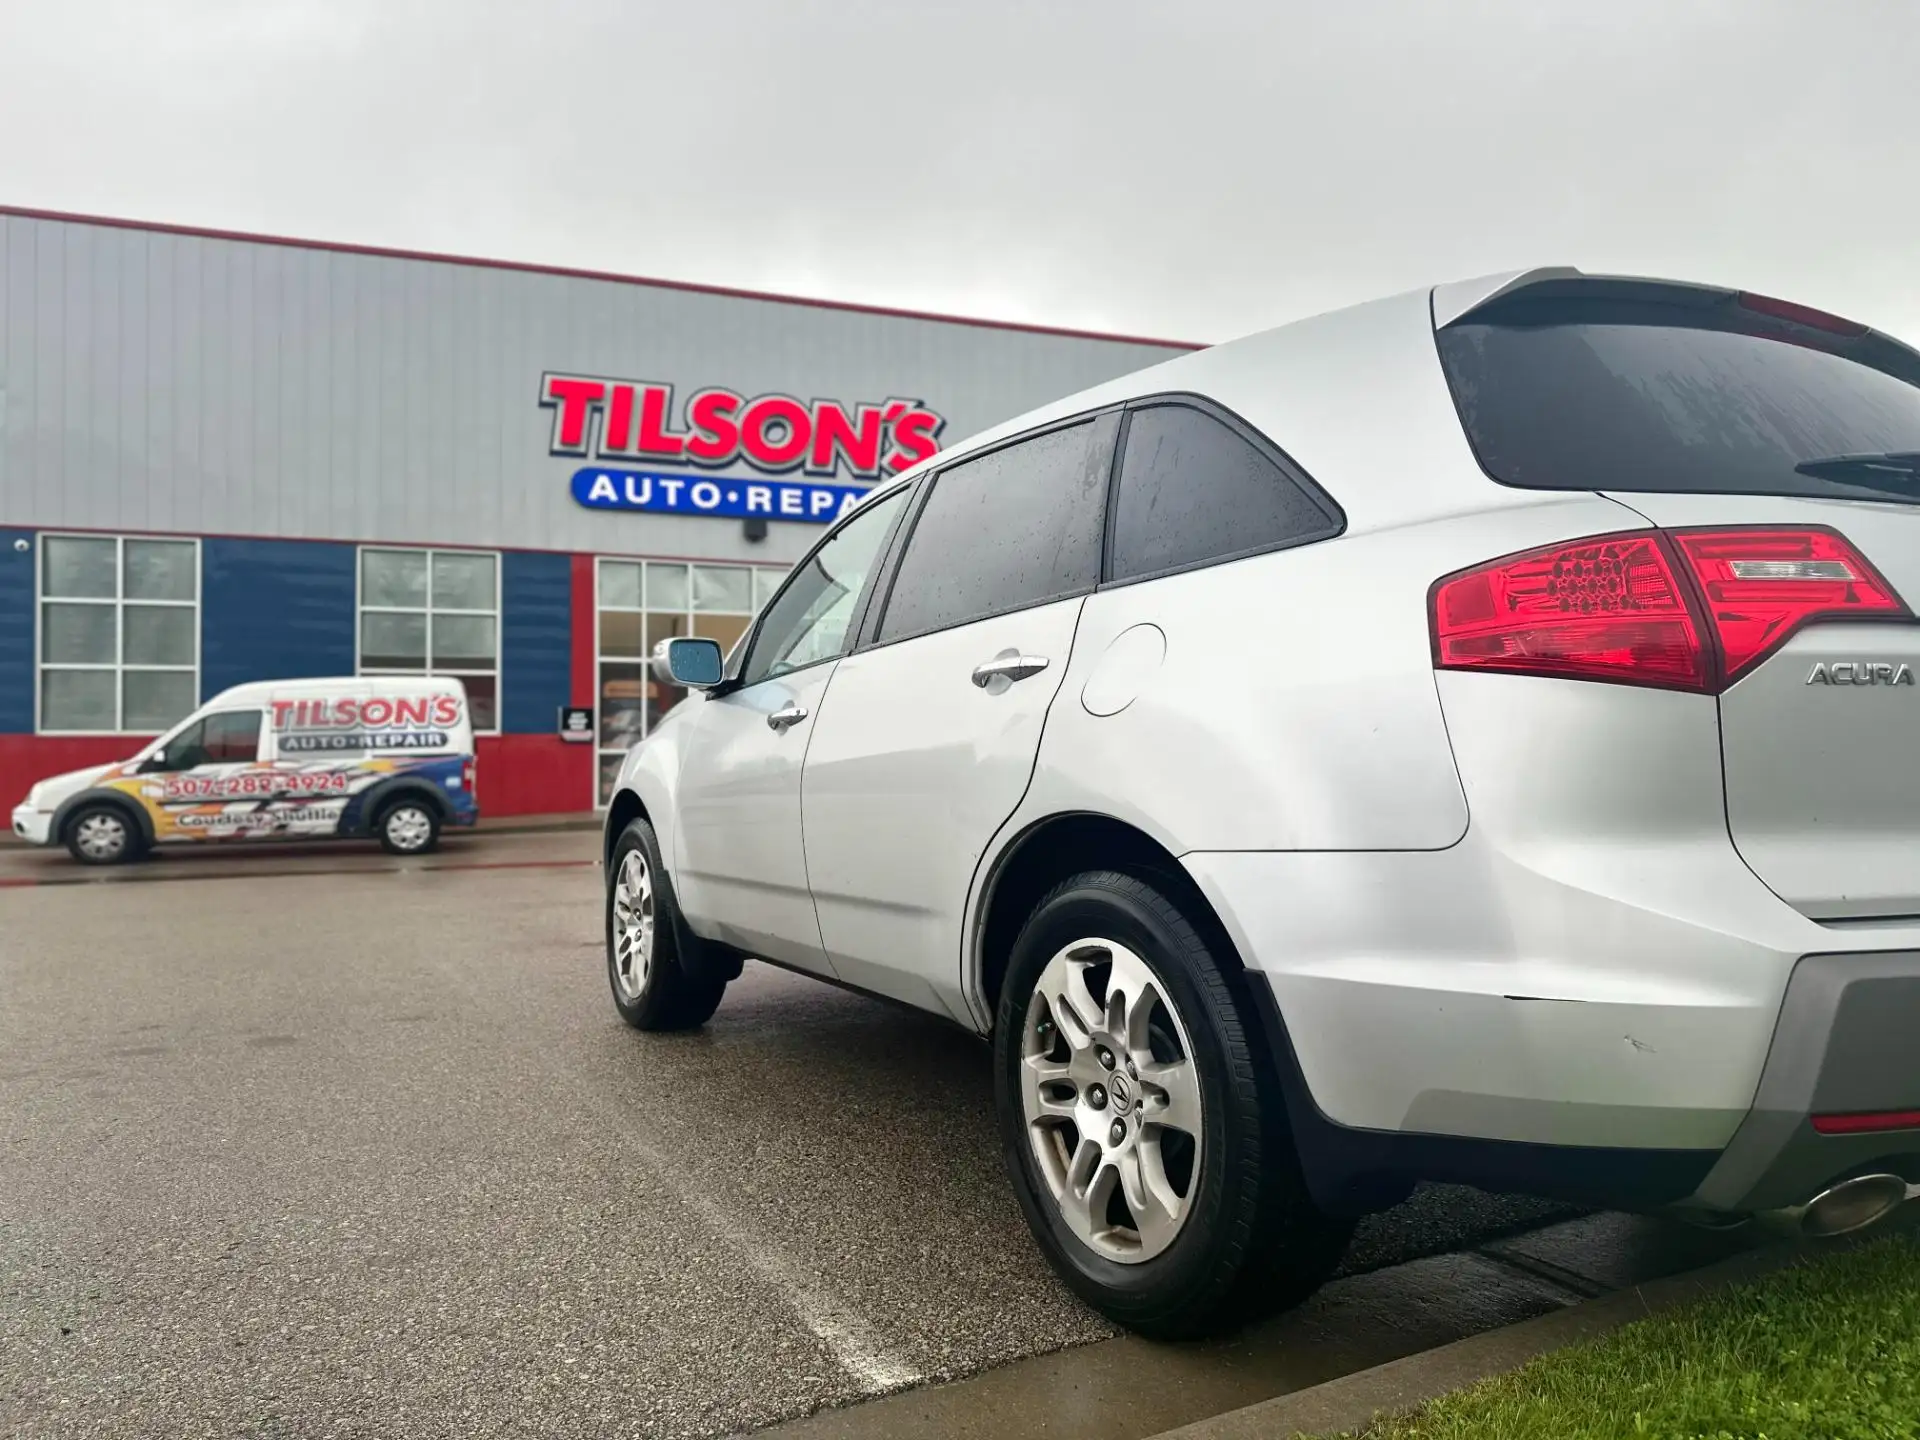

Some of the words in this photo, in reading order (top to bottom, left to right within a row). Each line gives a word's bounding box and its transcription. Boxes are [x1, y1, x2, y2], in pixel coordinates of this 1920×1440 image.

[547, 376, 942, 473] TILSON'S
[746, 484, 860, 518] REPA
[1805, 662, 1916, 686] ACURA
[270, 693, 460, 729] TILSON'S
[272, 807, 339, 823] Shuttle
